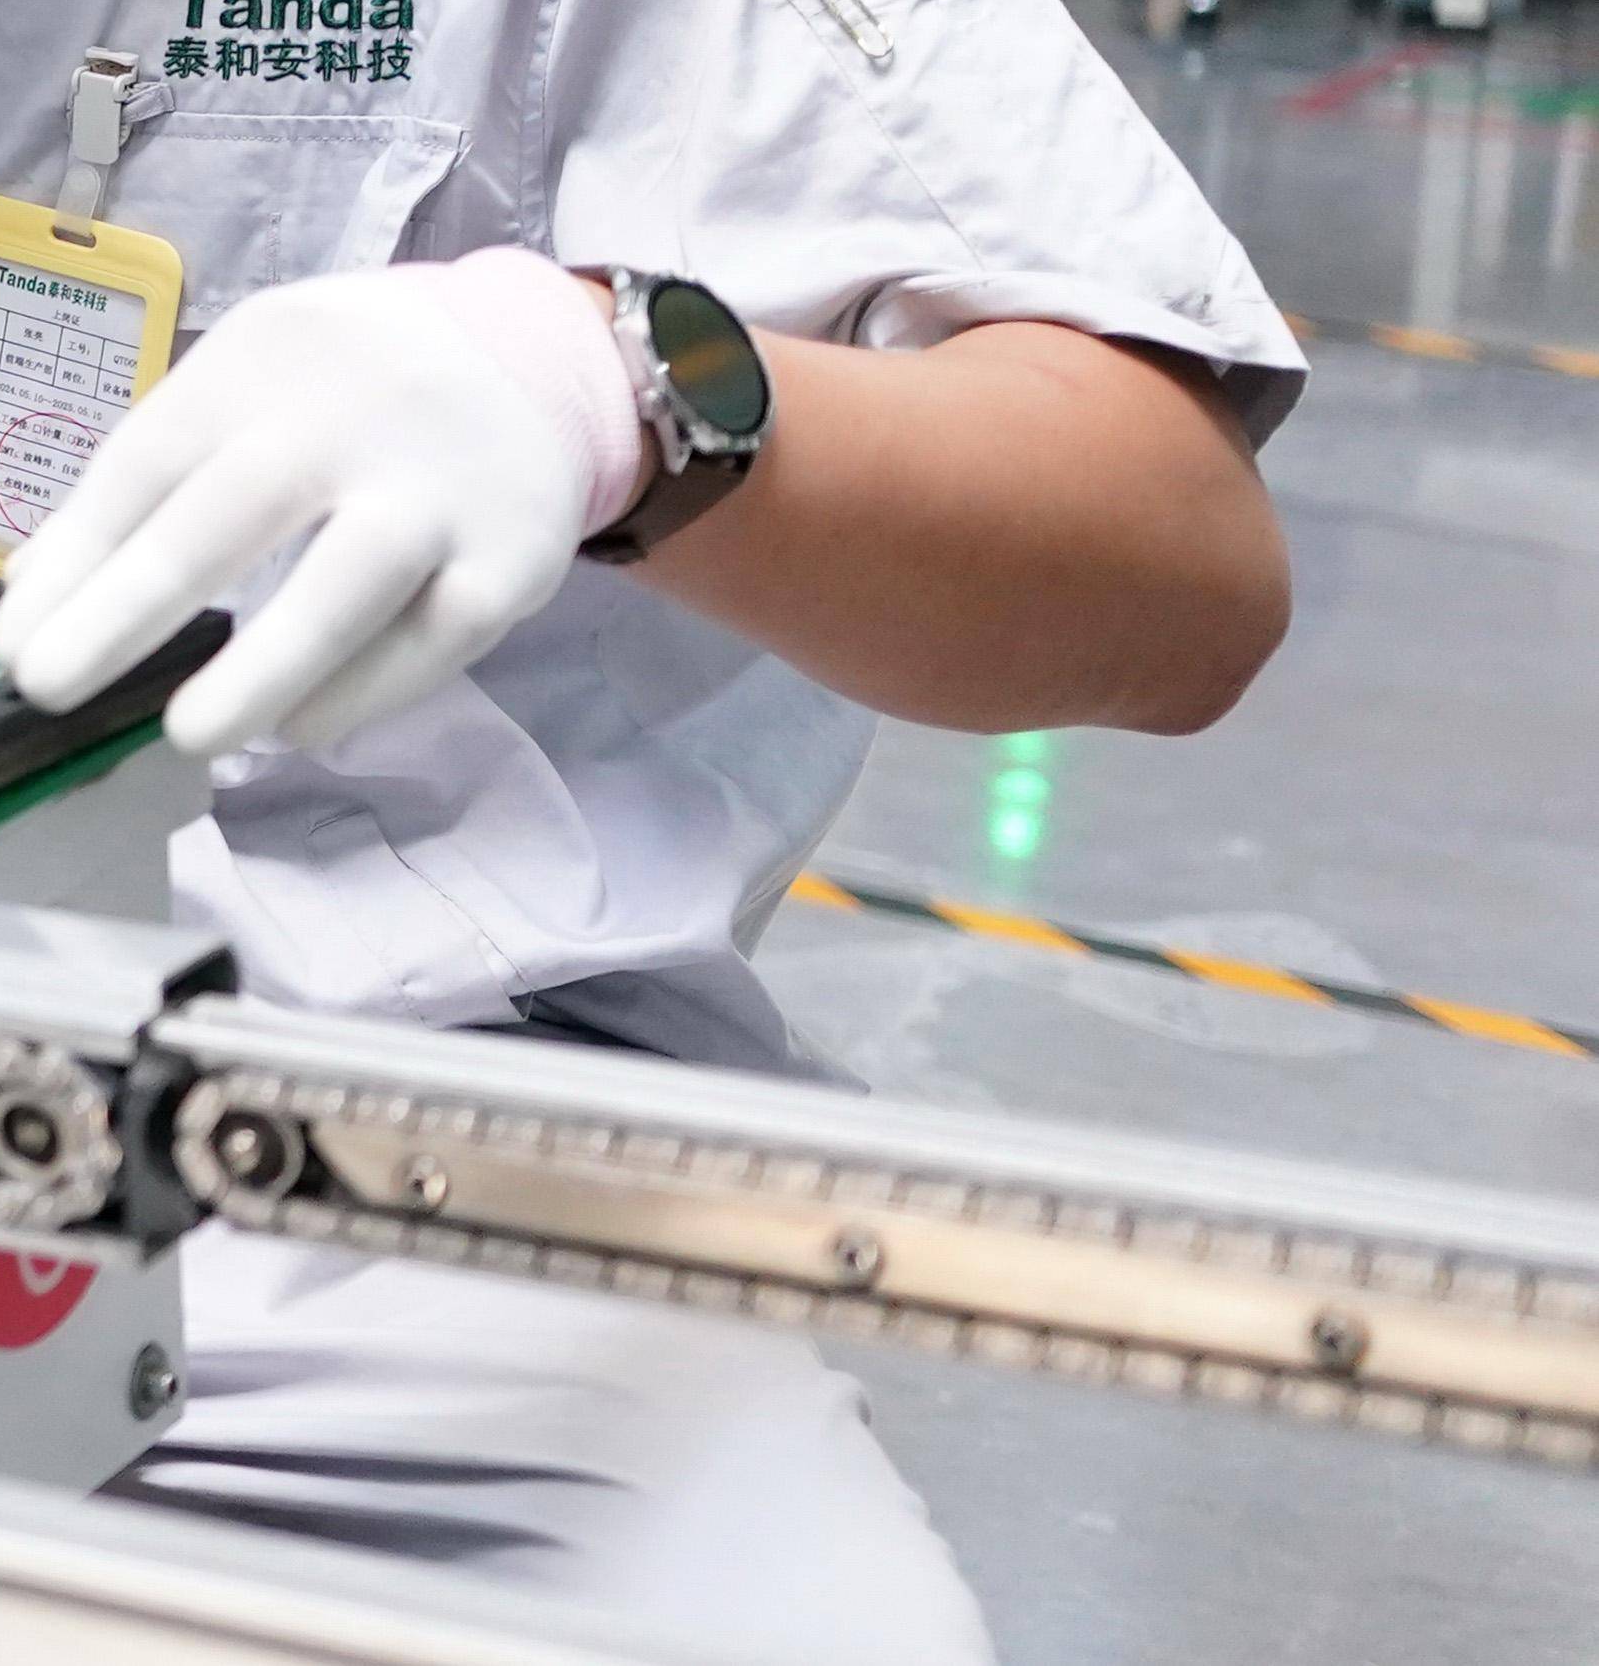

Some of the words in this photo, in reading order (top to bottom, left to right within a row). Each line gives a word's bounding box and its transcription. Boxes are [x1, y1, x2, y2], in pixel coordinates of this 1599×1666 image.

[163, 36, 414, 83] 泰和安科技
[0, 265, 47, 296] Tanda
[49, 281, 108, 313] 泰和安科技
